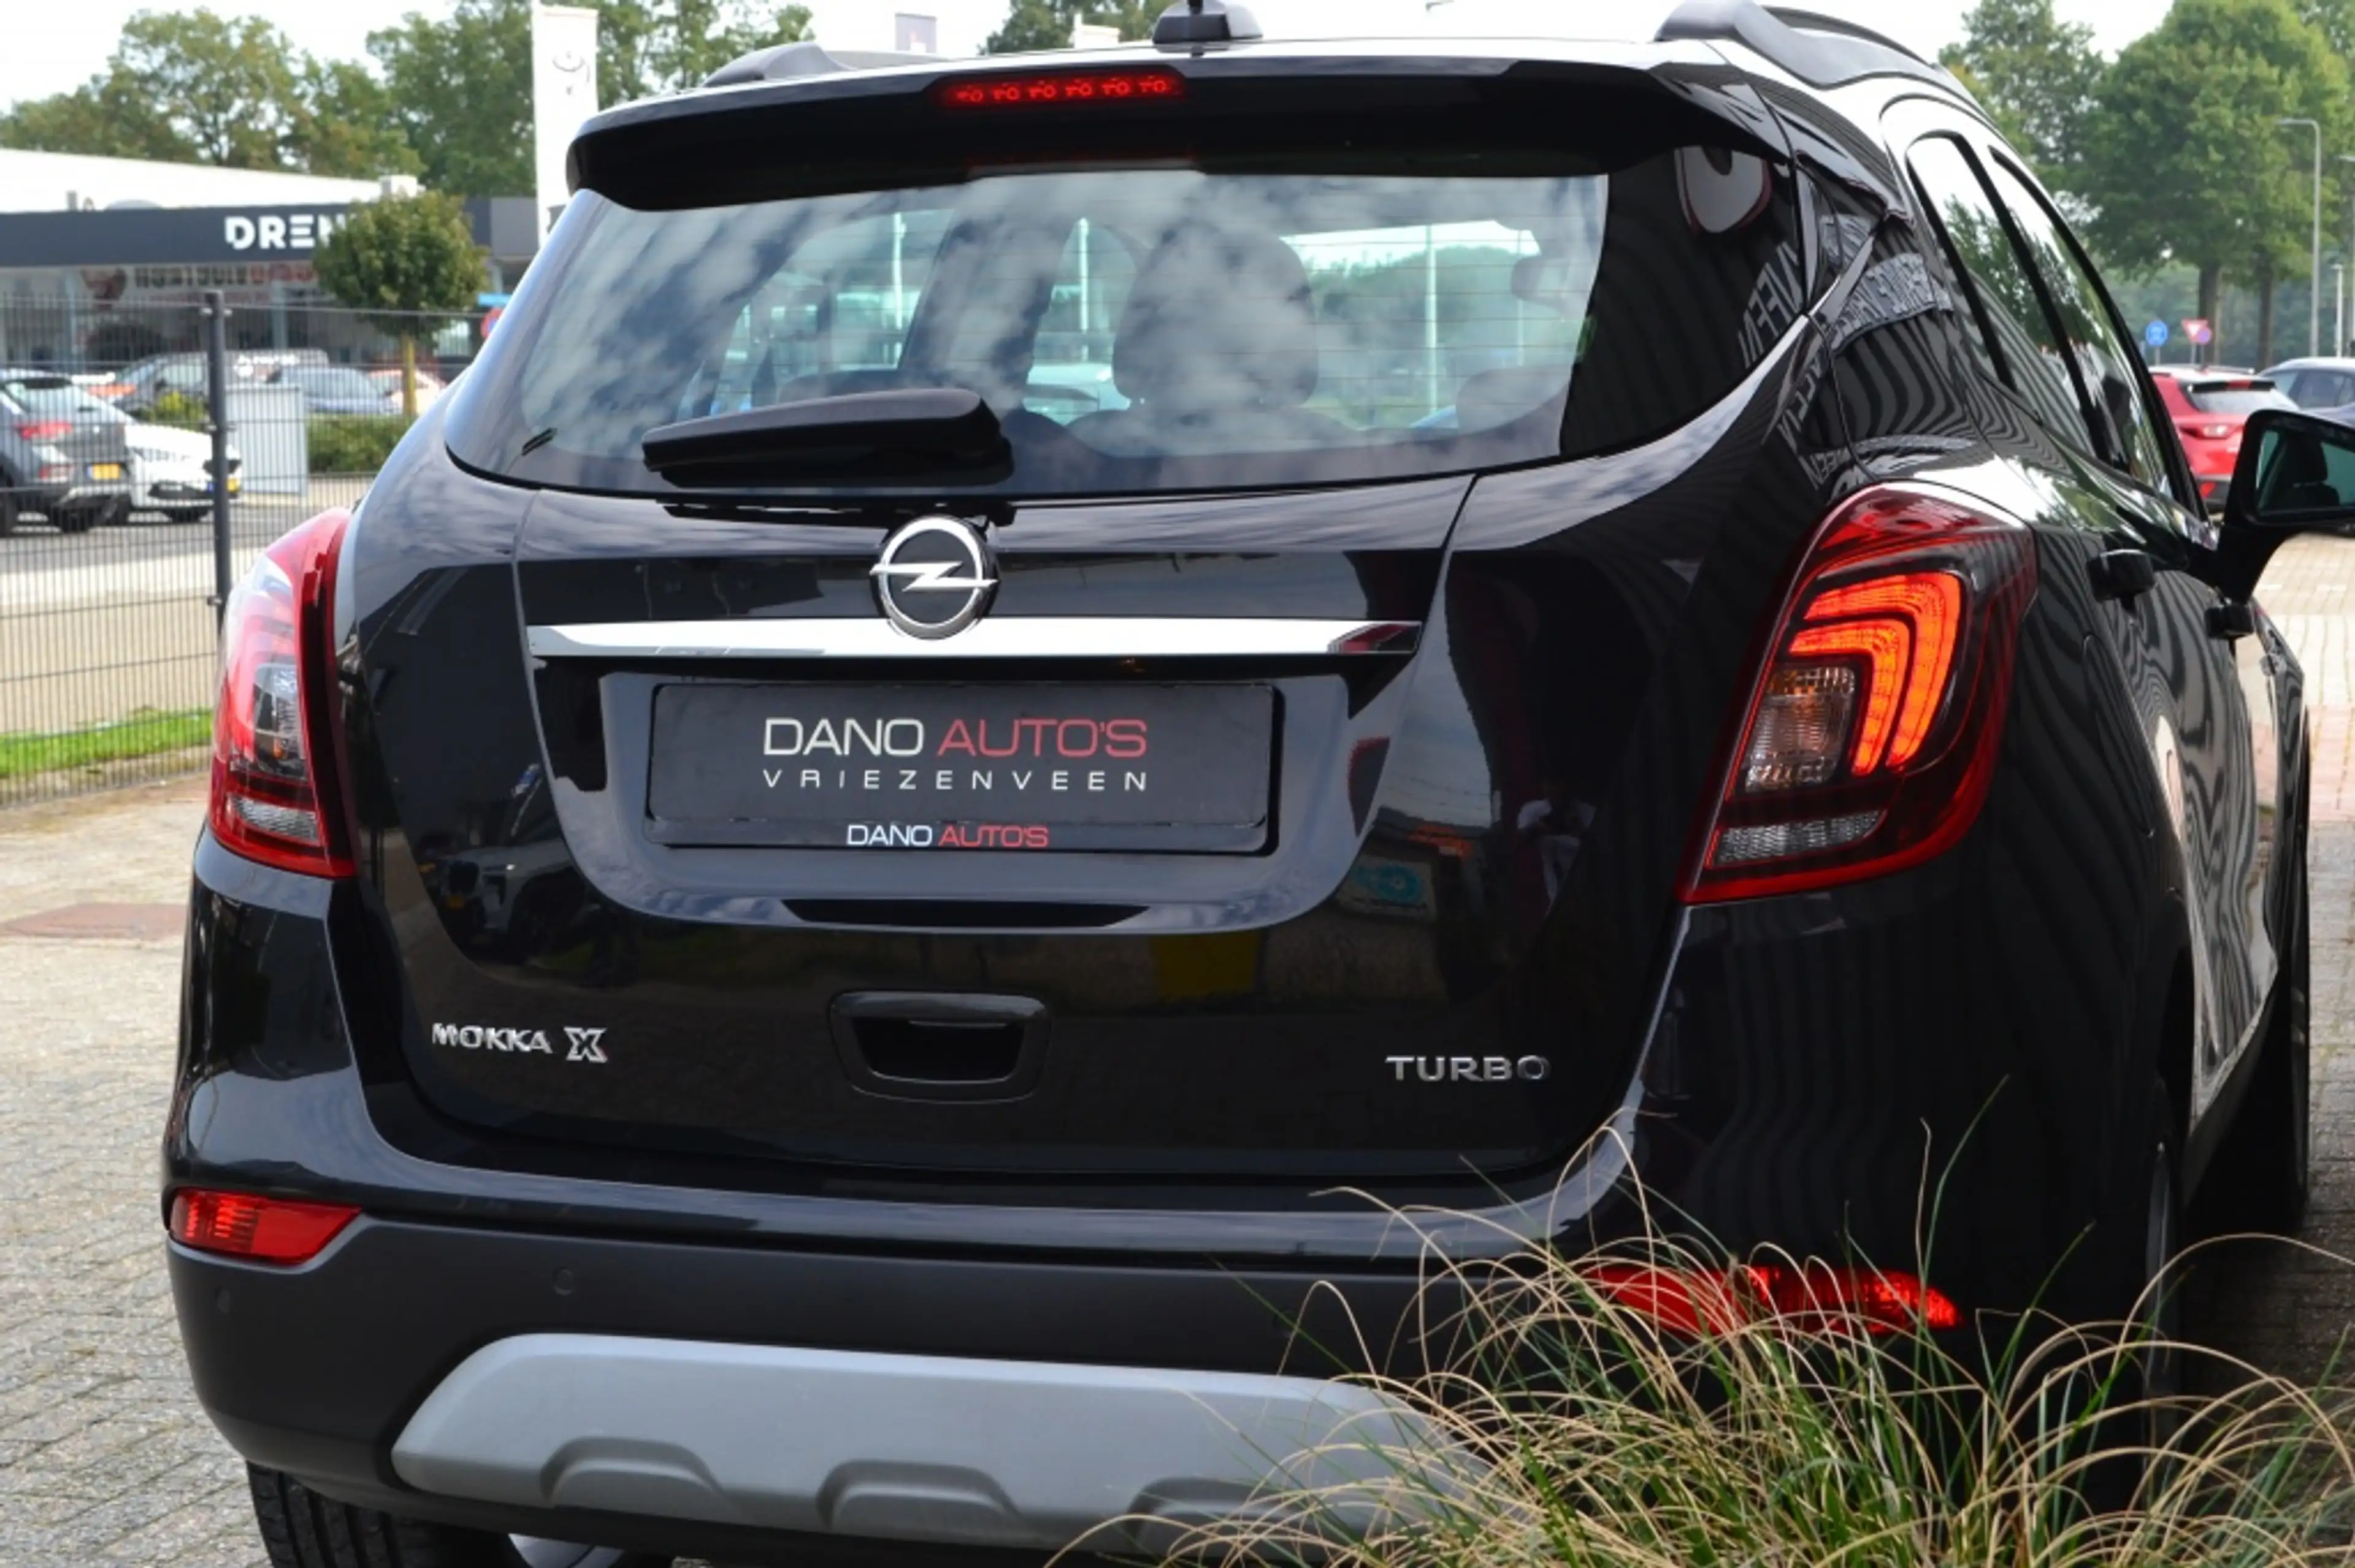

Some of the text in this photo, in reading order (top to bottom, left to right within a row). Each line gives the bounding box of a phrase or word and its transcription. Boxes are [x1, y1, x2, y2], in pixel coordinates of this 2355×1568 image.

[762, 718, 1148, 758] DANO AUTO'S
[762, 769, 1147, 792] VRIEZENVEEN
[846, 824, 1049, 848] DANO AUTO'S
[432, 1022, 608, 1064] MOKKA X
[1384, 1055, 1551, 1082] TURBO
